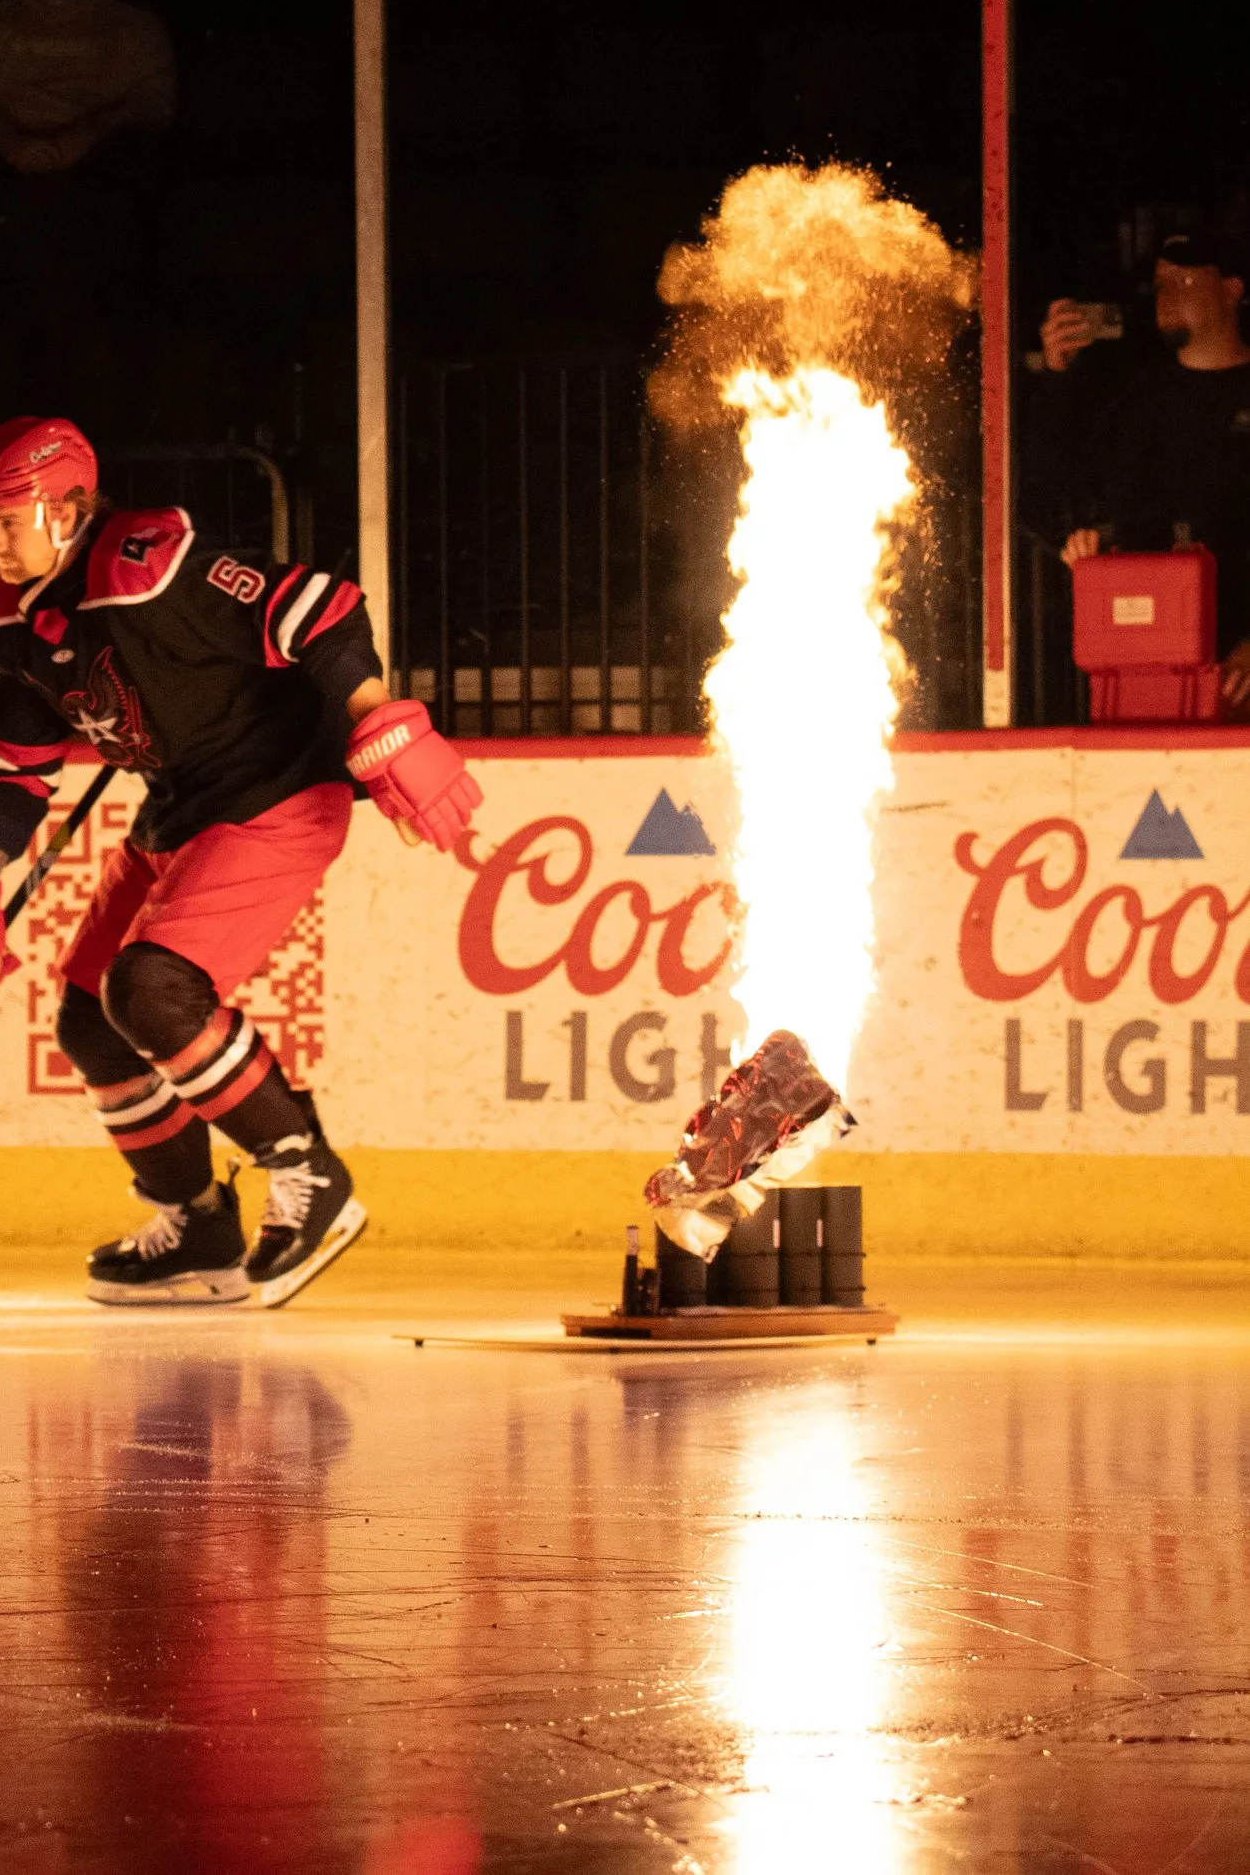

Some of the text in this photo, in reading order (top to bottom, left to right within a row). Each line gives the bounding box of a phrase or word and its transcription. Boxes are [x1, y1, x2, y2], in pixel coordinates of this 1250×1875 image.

[206, 555, 267, 604] 5
[451, 814, 742, 997] Coo
[953, 816, 1250, 1005] Coo
[505, 1010, 730, 1104] LIG
